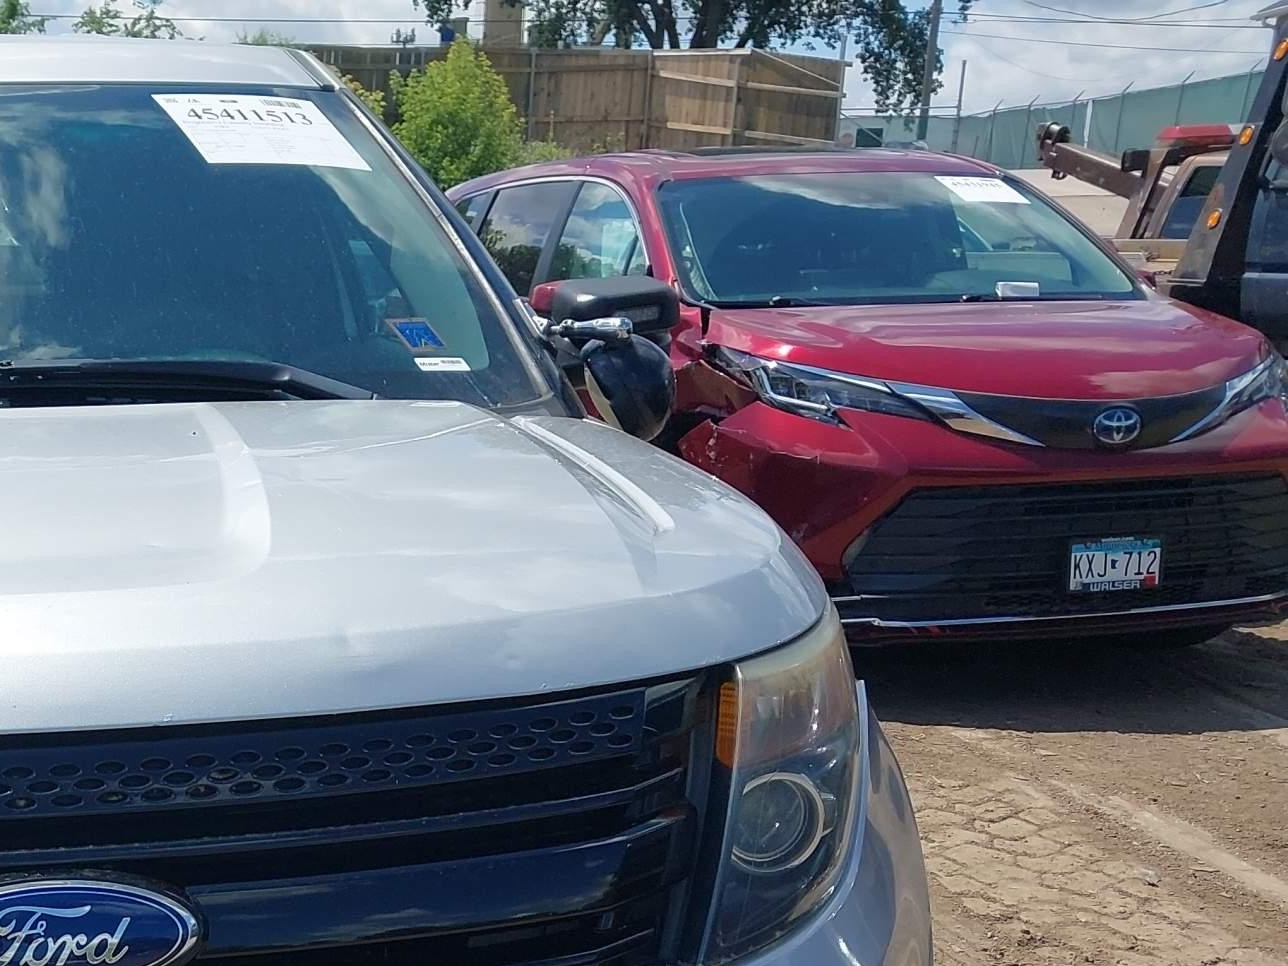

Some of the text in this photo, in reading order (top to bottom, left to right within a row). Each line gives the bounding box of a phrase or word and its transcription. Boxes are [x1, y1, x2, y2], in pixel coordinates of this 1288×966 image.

[187, 107, 313, 126] 45411513
[1073, 550, 1157, 580] KXJ 712
[1089, 580, 1141, 592] WALSER
